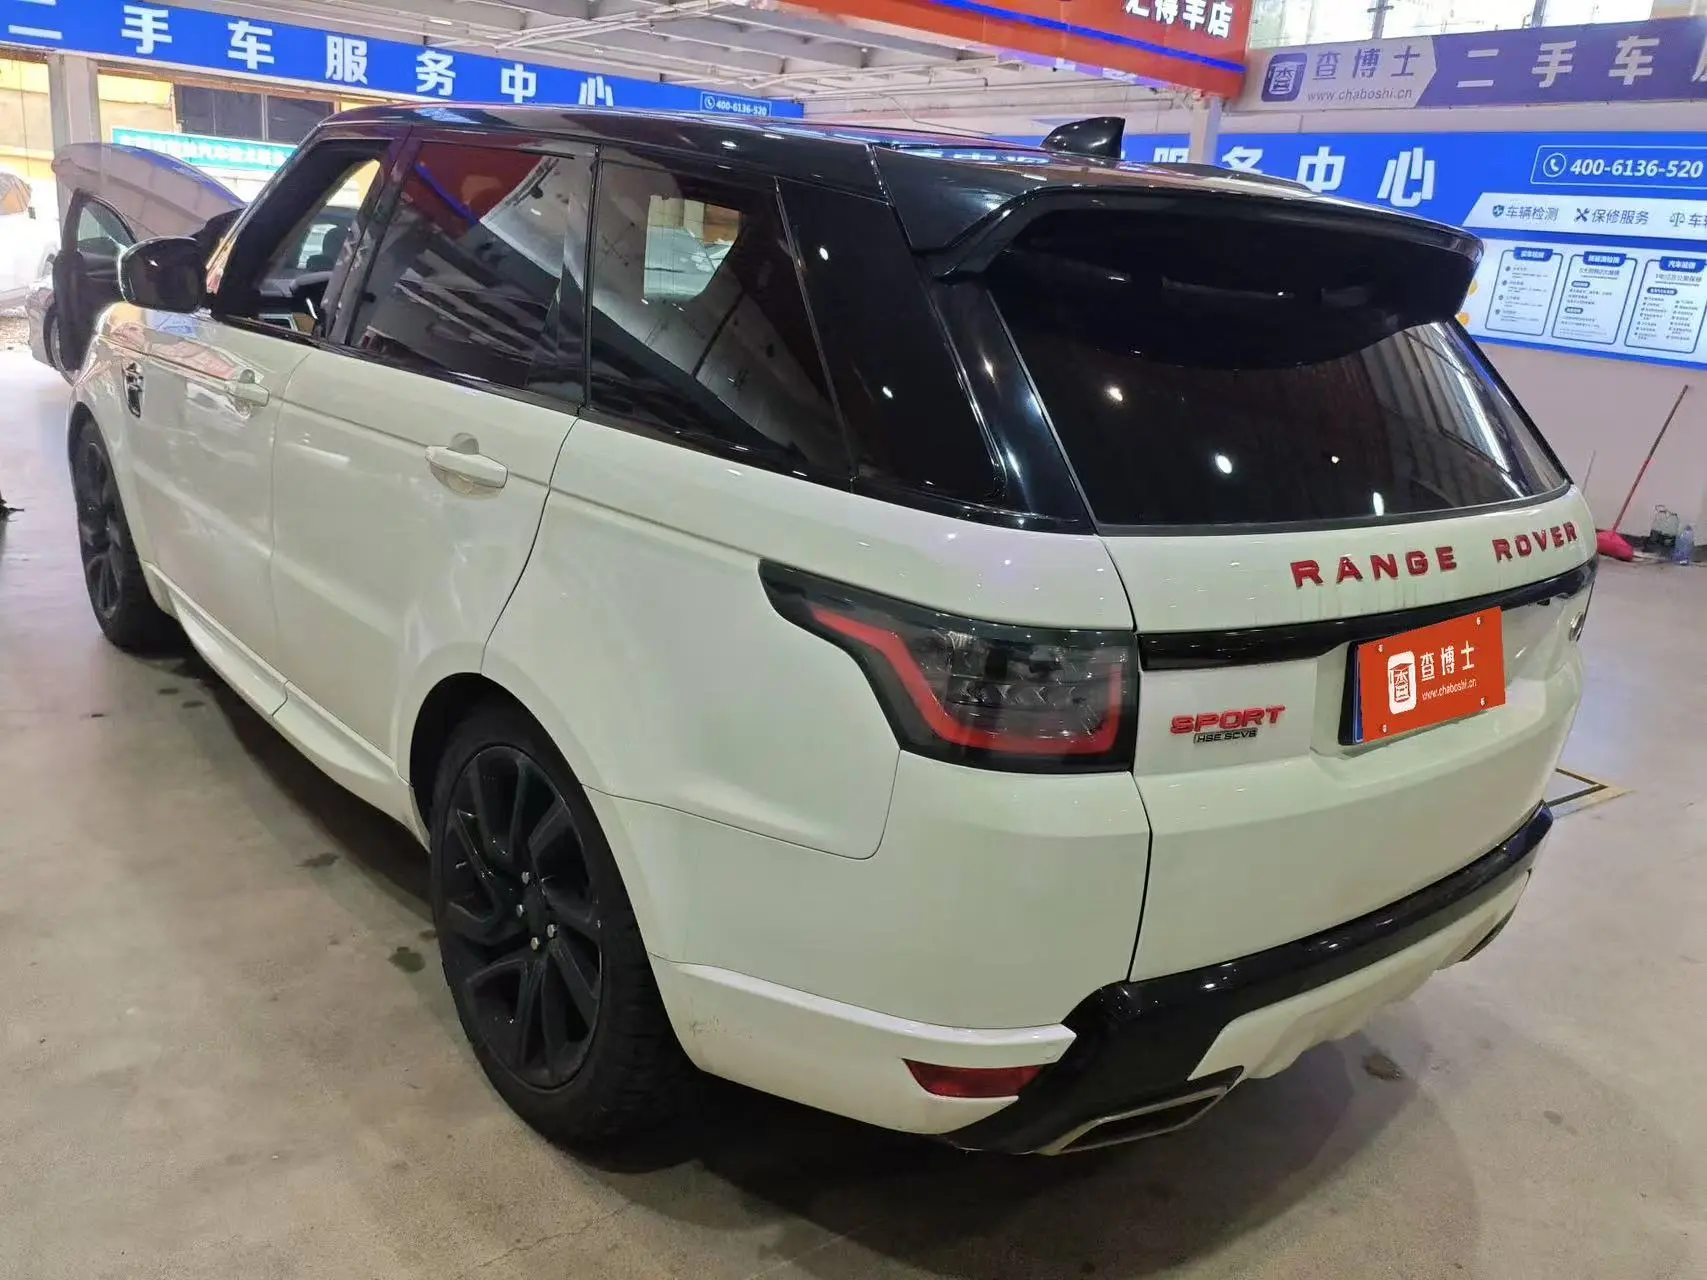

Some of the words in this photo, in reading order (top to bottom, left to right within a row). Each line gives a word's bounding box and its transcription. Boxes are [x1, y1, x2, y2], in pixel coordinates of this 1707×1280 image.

[8, 0, 614, 106] 二手车服务中心
[1312, 45, 1420, 80] 查博士
[1307, 87, 1412, 101] www.chaboshi.cn
[716, 100, 768, 116] 400-6136-520
[1570, 159, 1704, 178] 400-6136-520
[1505, 206, 1559, 221] 车辆检测
[1591, 208, 1649, 225] 保修服务
[1290, 546, 1457, 589] RANGE
[1492, 521, 1577, 562] ROVER
[1170, 704, 1285, 734] SPORT
[1196, 732, 1222, 743] HSE
